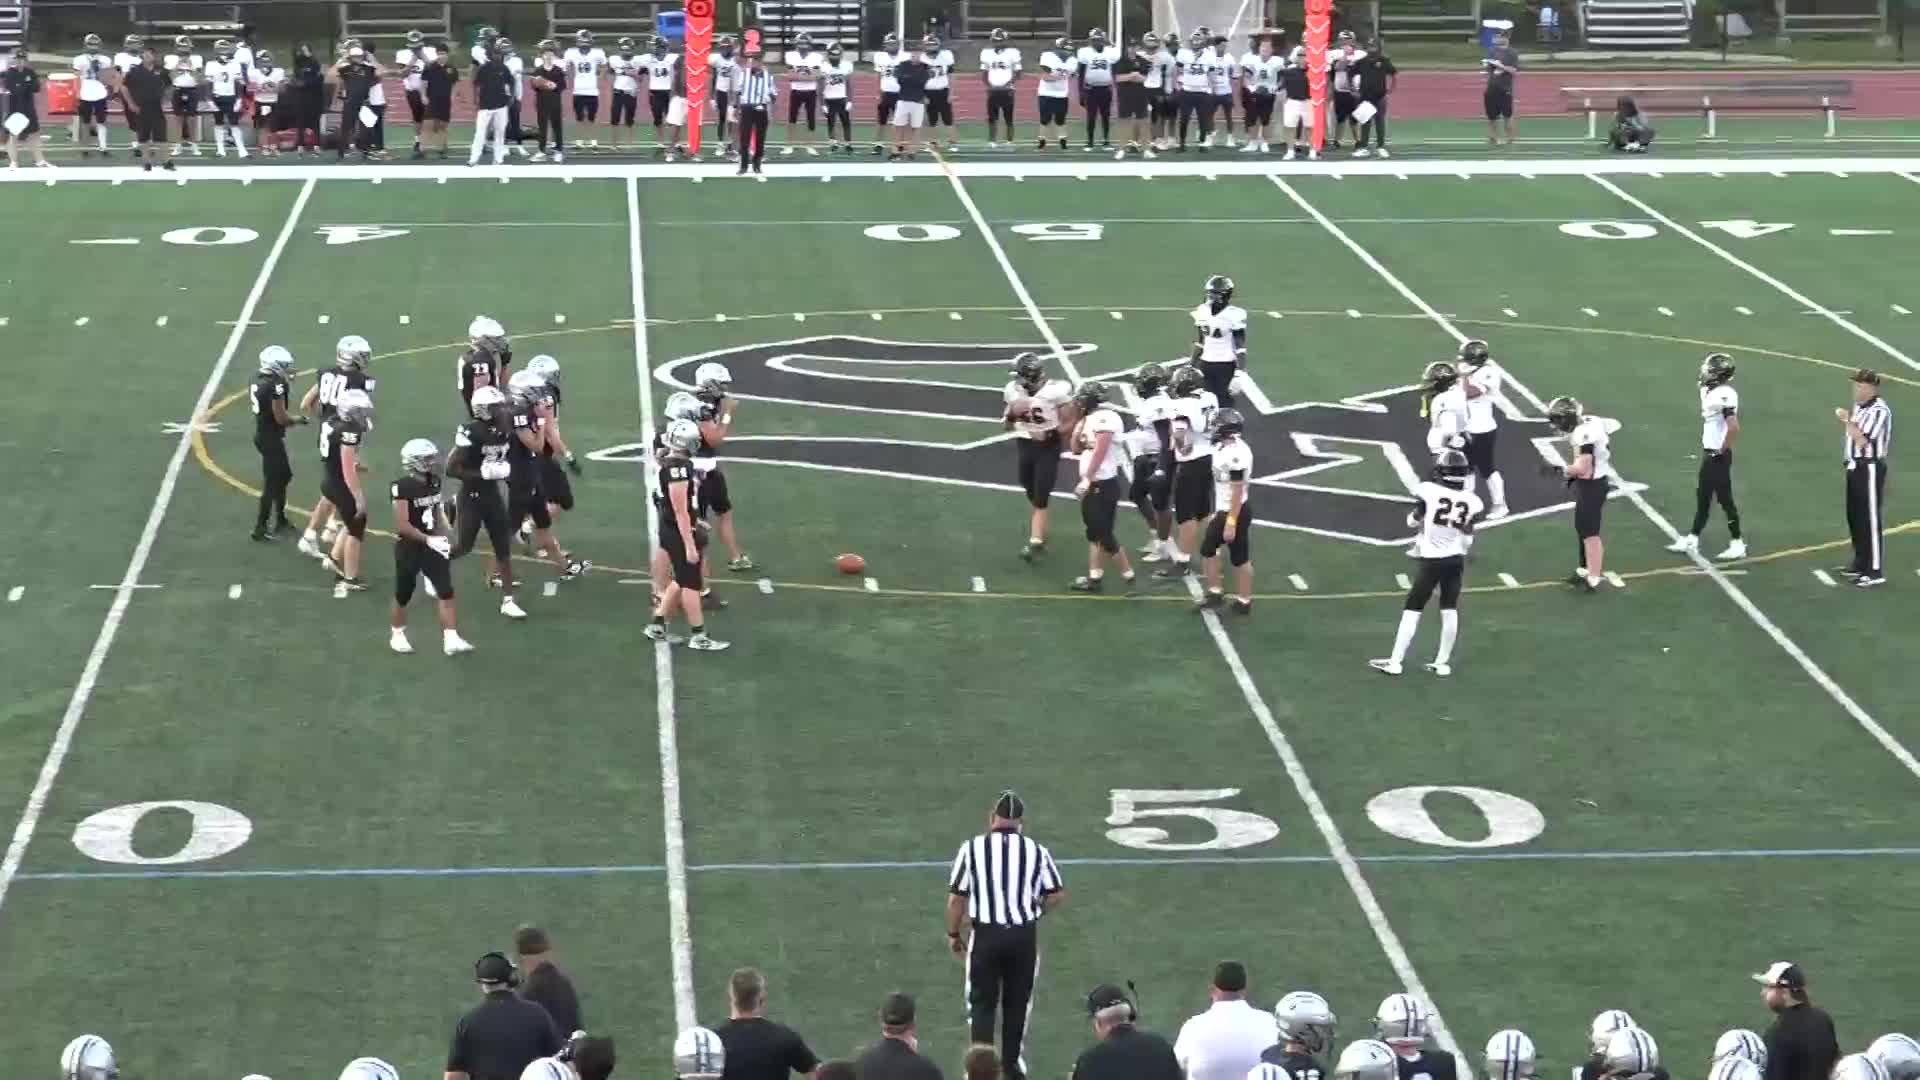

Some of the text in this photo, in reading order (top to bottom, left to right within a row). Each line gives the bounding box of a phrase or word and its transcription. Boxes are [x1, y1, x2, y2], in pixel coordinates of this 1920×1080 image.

[863, 223, 1104, 241] 50
[420, 507, 434, 530] 4
[1433, 497, 1469, 529] 23
[1104, 785, 1546, 850] 50
